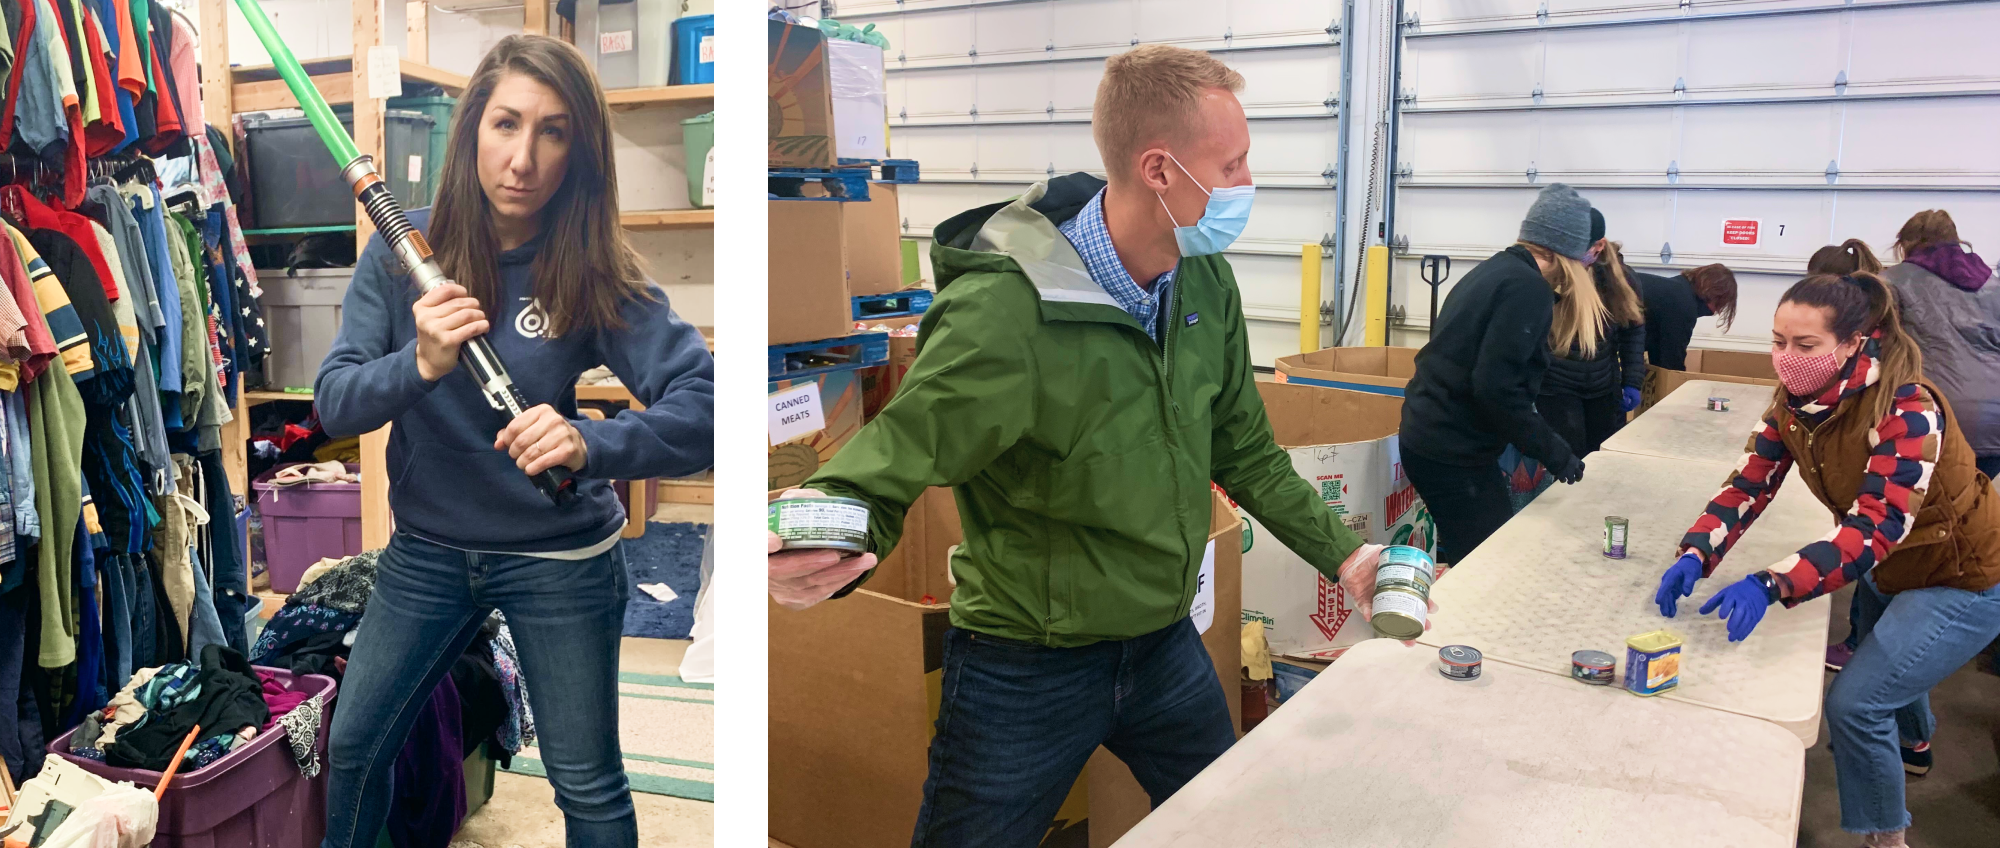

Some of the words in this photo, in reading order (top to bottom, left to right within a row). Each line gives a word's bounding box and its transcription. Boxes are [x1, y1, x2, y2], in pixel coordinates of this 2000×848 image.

[602, 34, 626, 53] BAGS
[857, 136, 867, 147] 17
[1779, 224, 1785, 236] 7
[775, 394, 811, 412] CANNED
[781, 409, 811, 426] MEATS
[1327, 597, 1336, 625] STEP
